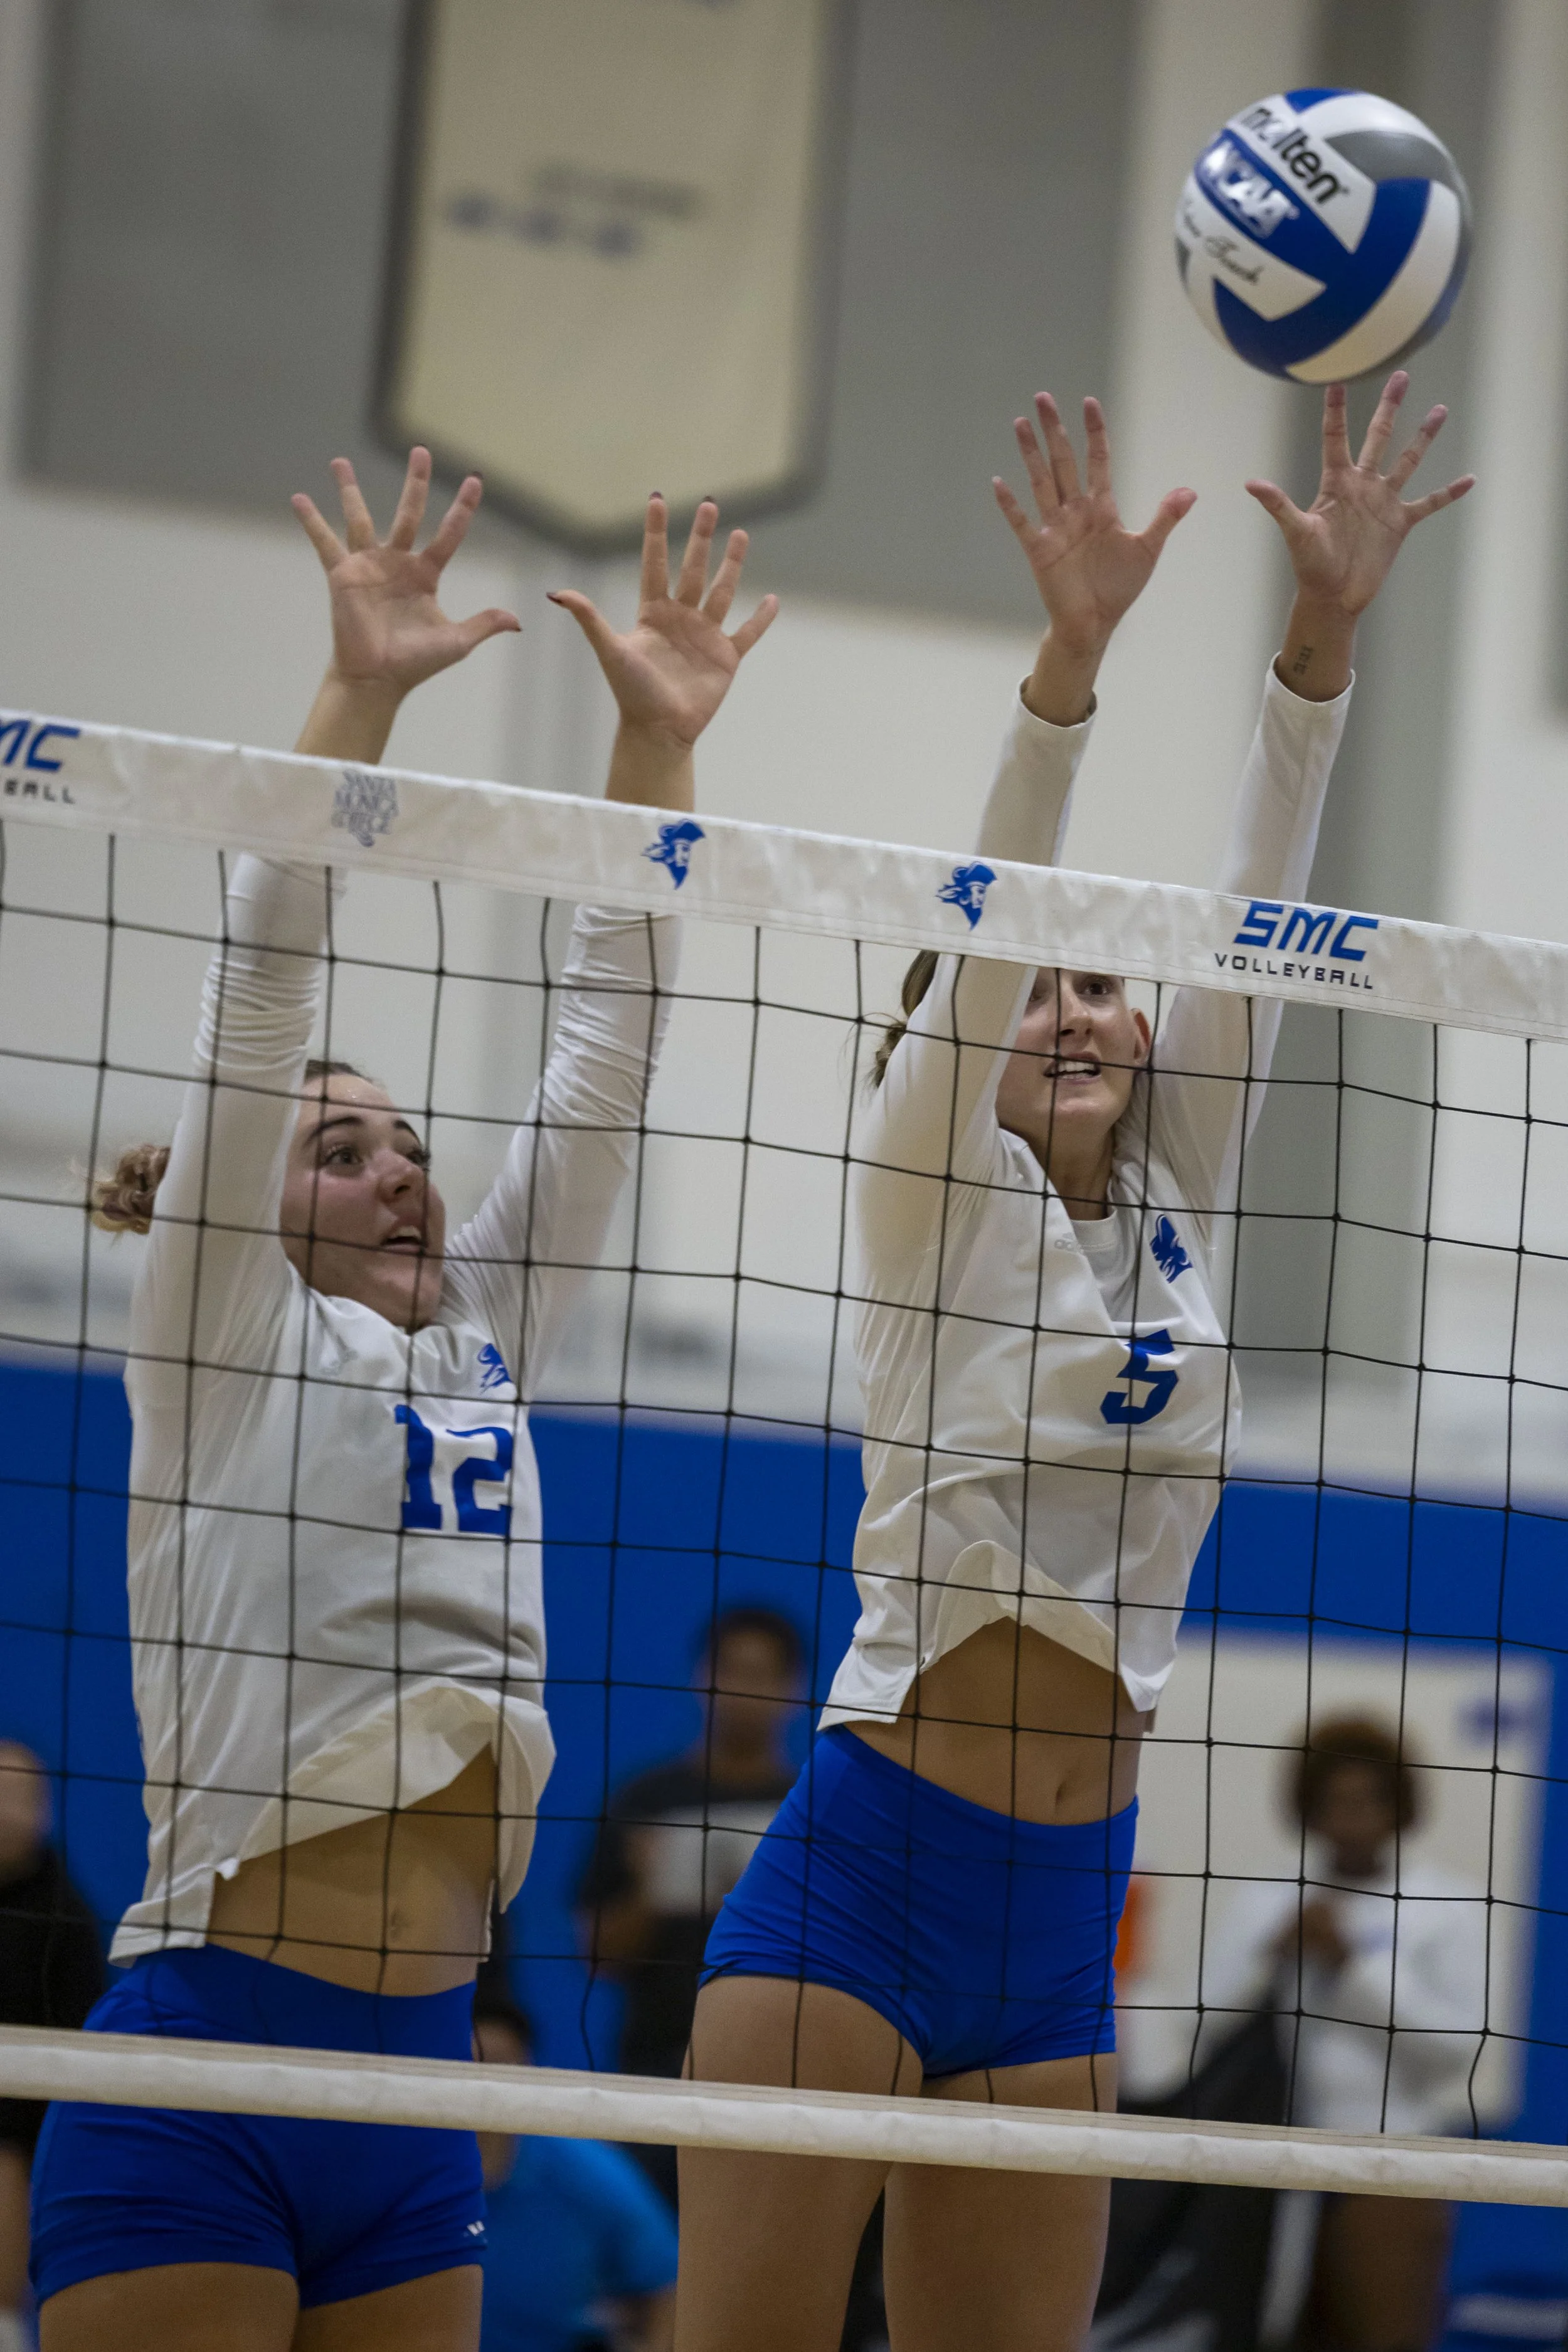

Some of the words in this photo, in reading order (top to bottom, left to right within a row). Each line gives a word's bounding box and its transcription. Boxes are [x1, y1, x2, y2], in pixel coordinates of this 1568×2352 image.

[1233, 901, 1379, 961] SMC
[1214, 952, 1374, 990] VOLLEYBALL
[1100, 1328, 1180, 1424] 5
[394, 1404, 513, 1535] 12
